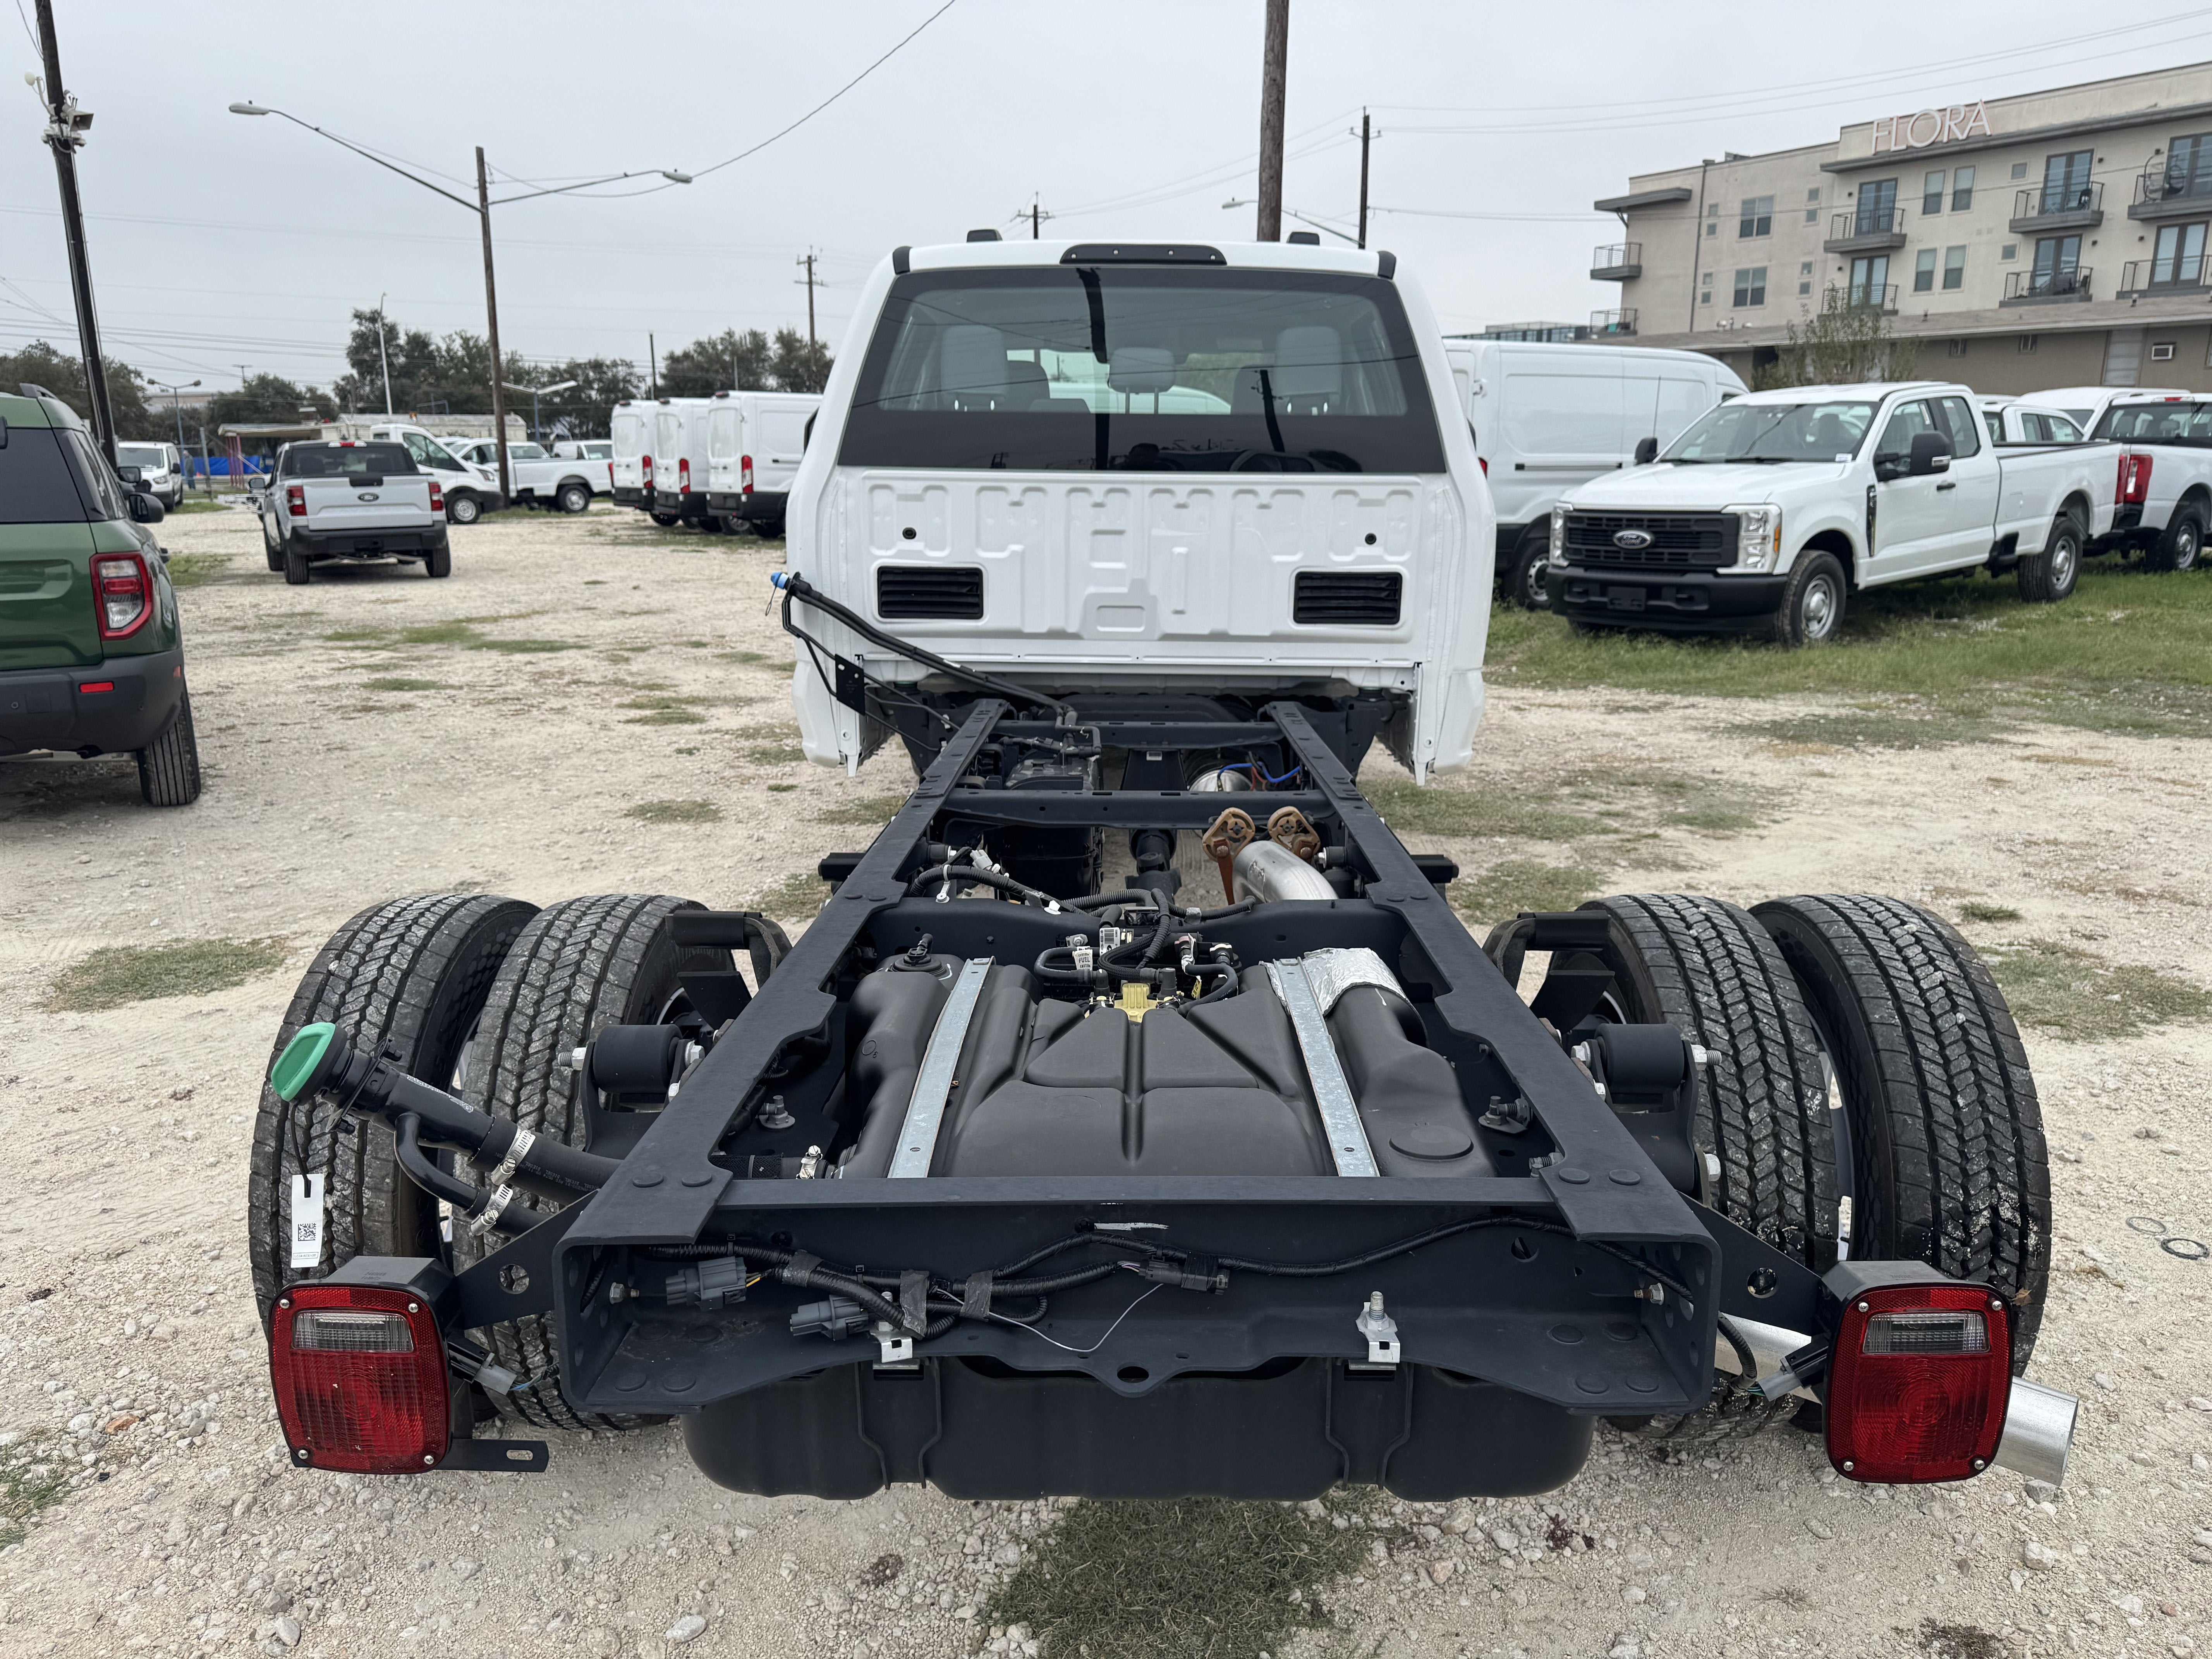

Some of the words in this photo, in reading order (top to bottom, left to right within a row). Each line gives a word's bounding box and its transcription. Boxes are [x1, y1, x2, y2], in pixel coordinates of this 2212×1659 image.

[1872, 99, 1992, 155] FLORA
[524, 1161, 541, 1171] DIESEL
[544, 1170, 560, 1178] DIESEL
[564, 1176, 580, 1185] DIESEL
